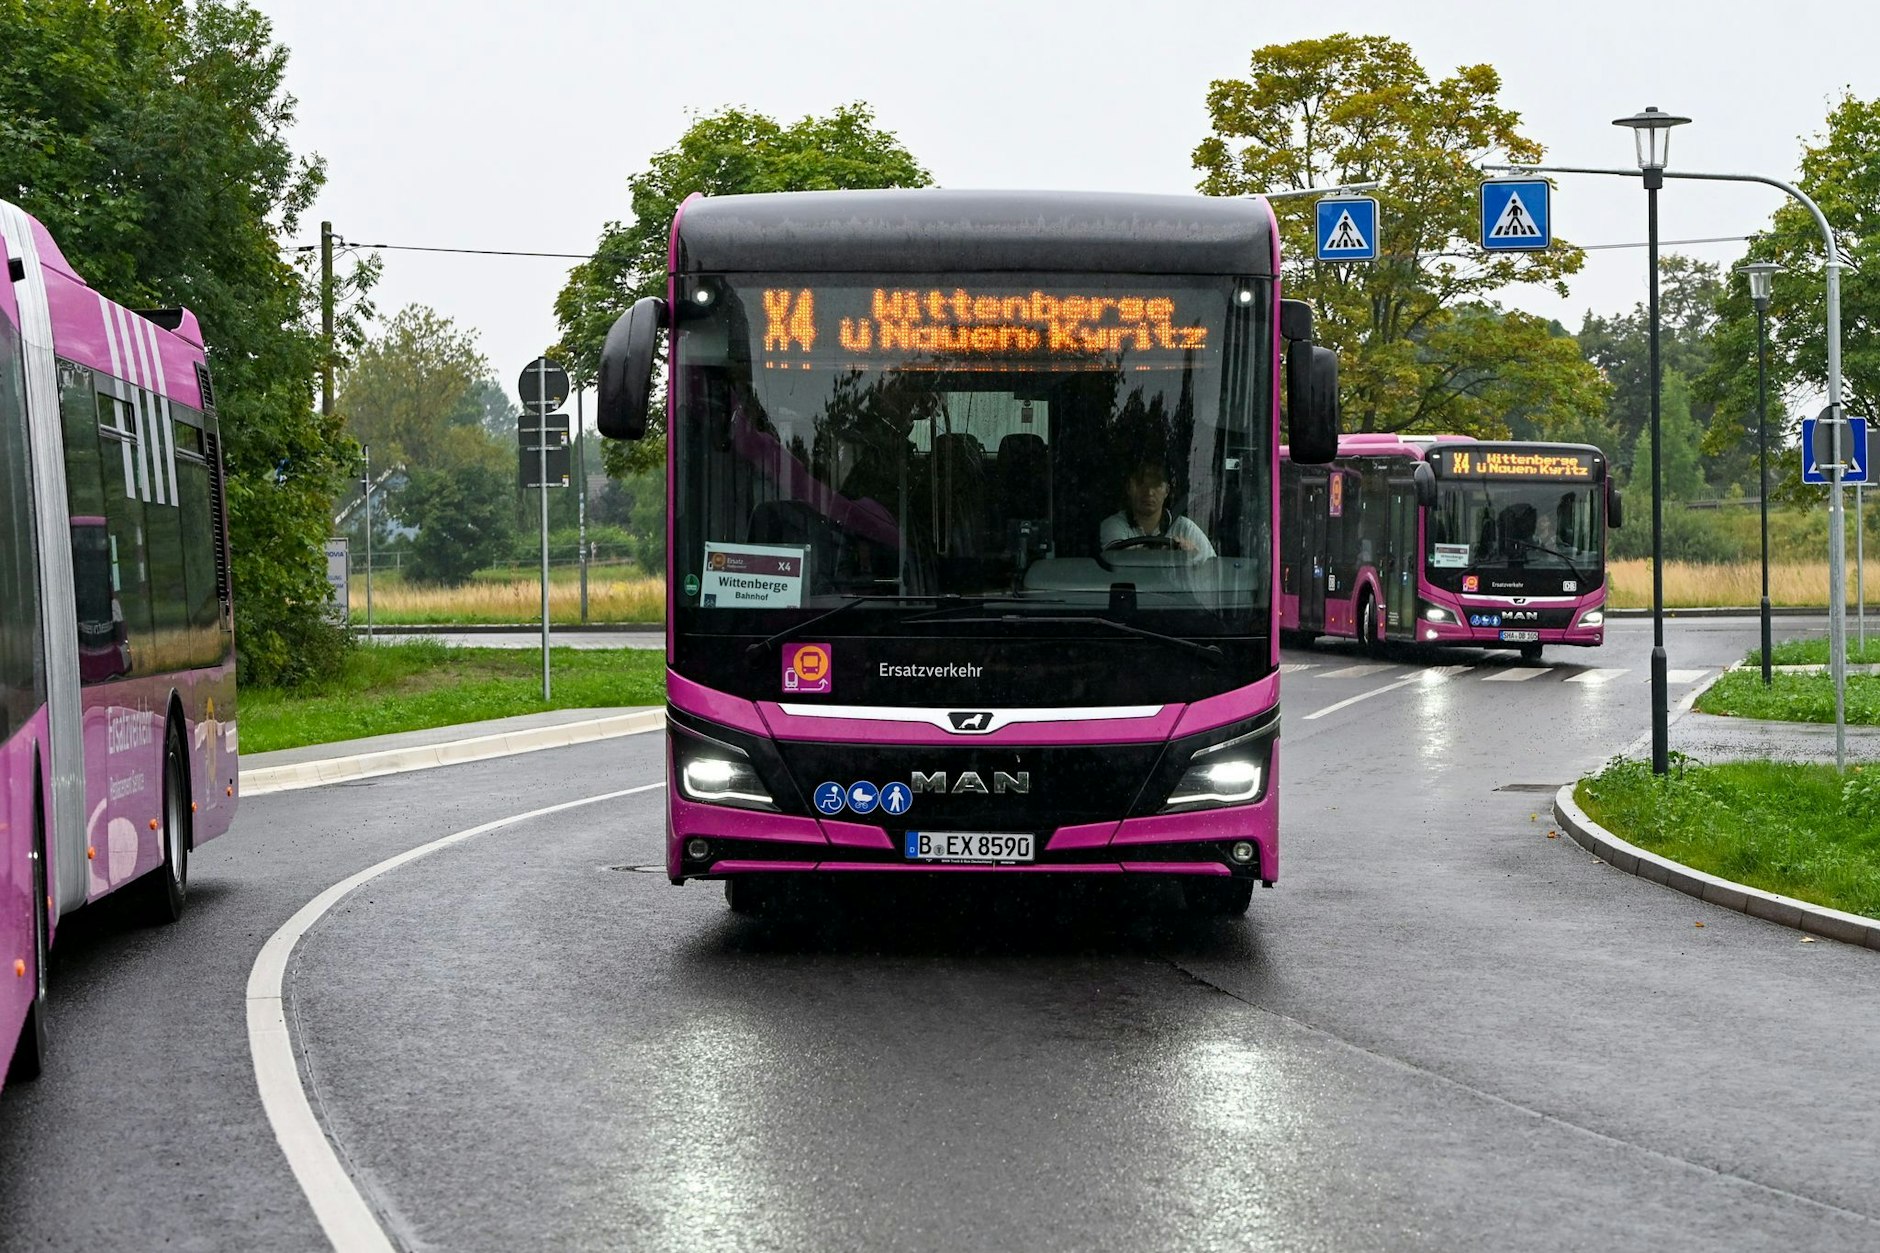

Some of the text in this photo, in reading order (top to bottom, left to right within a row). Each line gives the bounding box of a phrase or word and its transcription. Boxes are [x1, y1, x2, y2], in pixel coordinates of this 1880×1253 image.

[872, 288, 1174, 323] Wittenberge
[762, 288, 815, 352] X4
[1048, 319, 1208, 352] Kyritz
[1453, 452, 1470, 474] X4
[1486, 453, 1579, 465] Wittenberge
[1540, 465, 1588, 476] Kyritz
[778, 561, 792, 572] X4
[719, 576, 788, 593] Wittenberge
[1491, 581, 1524, 589] Ersatzverkehr
[735, 591, 769, 601] Bahnhof
[1501, 611, 1538, 620] MAN
[879, 662, 983, 678] Ersatzverkehr
[108, 697, 153, 754] Ersatzverkehr
[911, 772, 1029, 793] MAN
[919, 835, 1030, 857] B EX 8590
